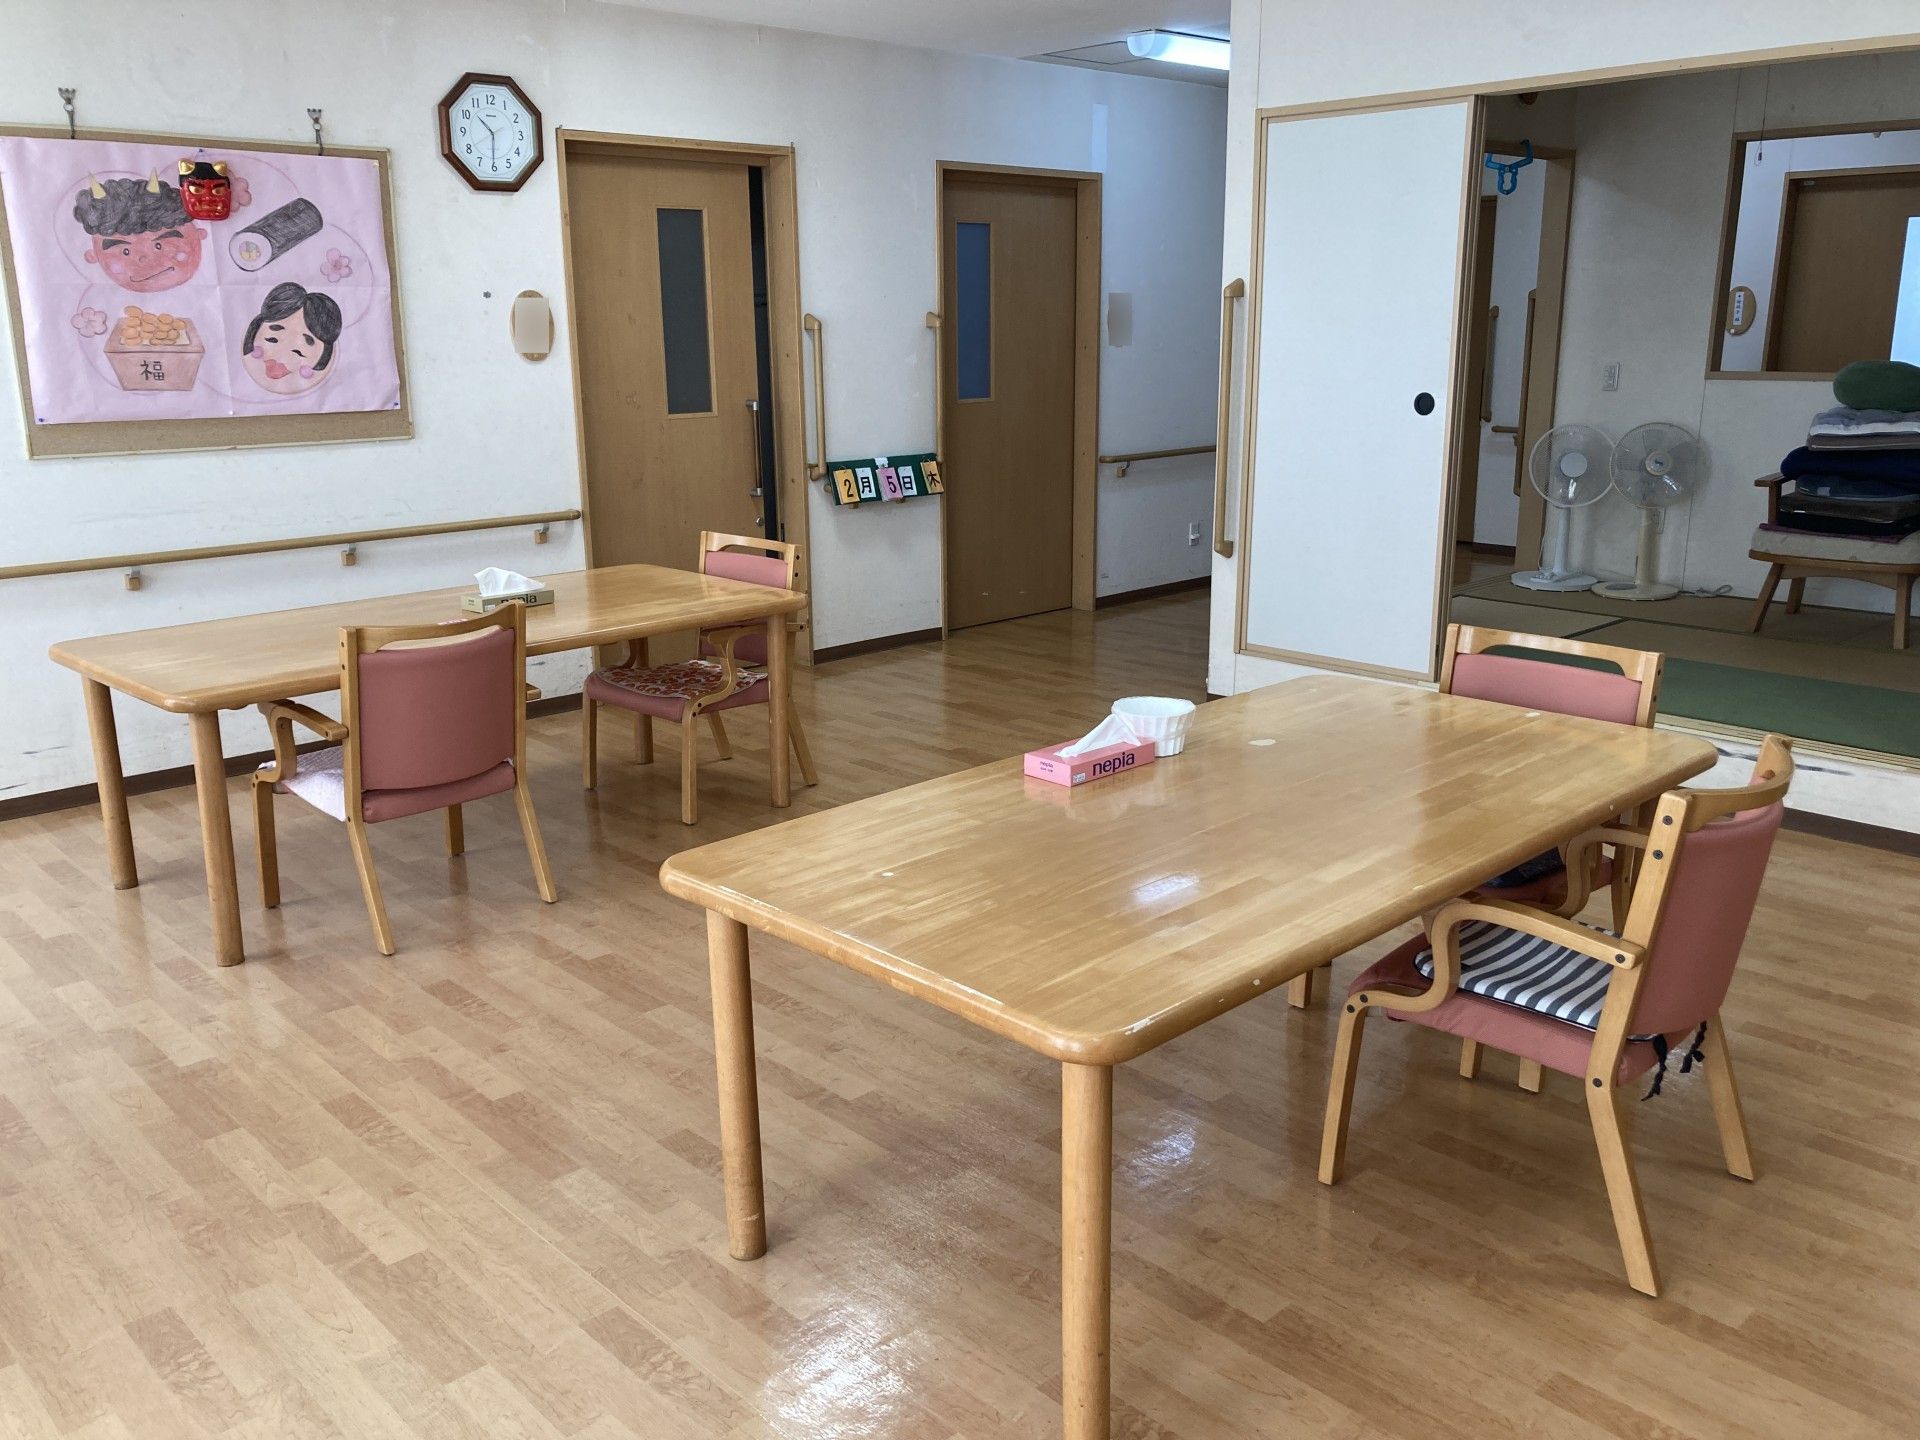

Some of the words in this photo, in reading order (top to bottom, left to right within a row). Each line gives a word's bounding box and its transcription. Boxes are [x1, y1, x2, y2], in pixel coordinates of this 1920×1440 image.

[472, 97, 480, 108] 11
[486, 94, 495, 105] 12
[461, 109, 471, 119] 10
[513, 113, 519, 123] 2
[460, 126, 467, 137] 9
[518, 130, 524, 141] 3
[466, 143, 472, 154] 8
[514, 147, 520, 157] 4
[477, 157, 483, 167] 7
[491, 162, 498, 172] 6
[505, 158, 512, 169] 5
[140, 360, 165, 381] 福
[1092, 751, 1135, 776] nepia
